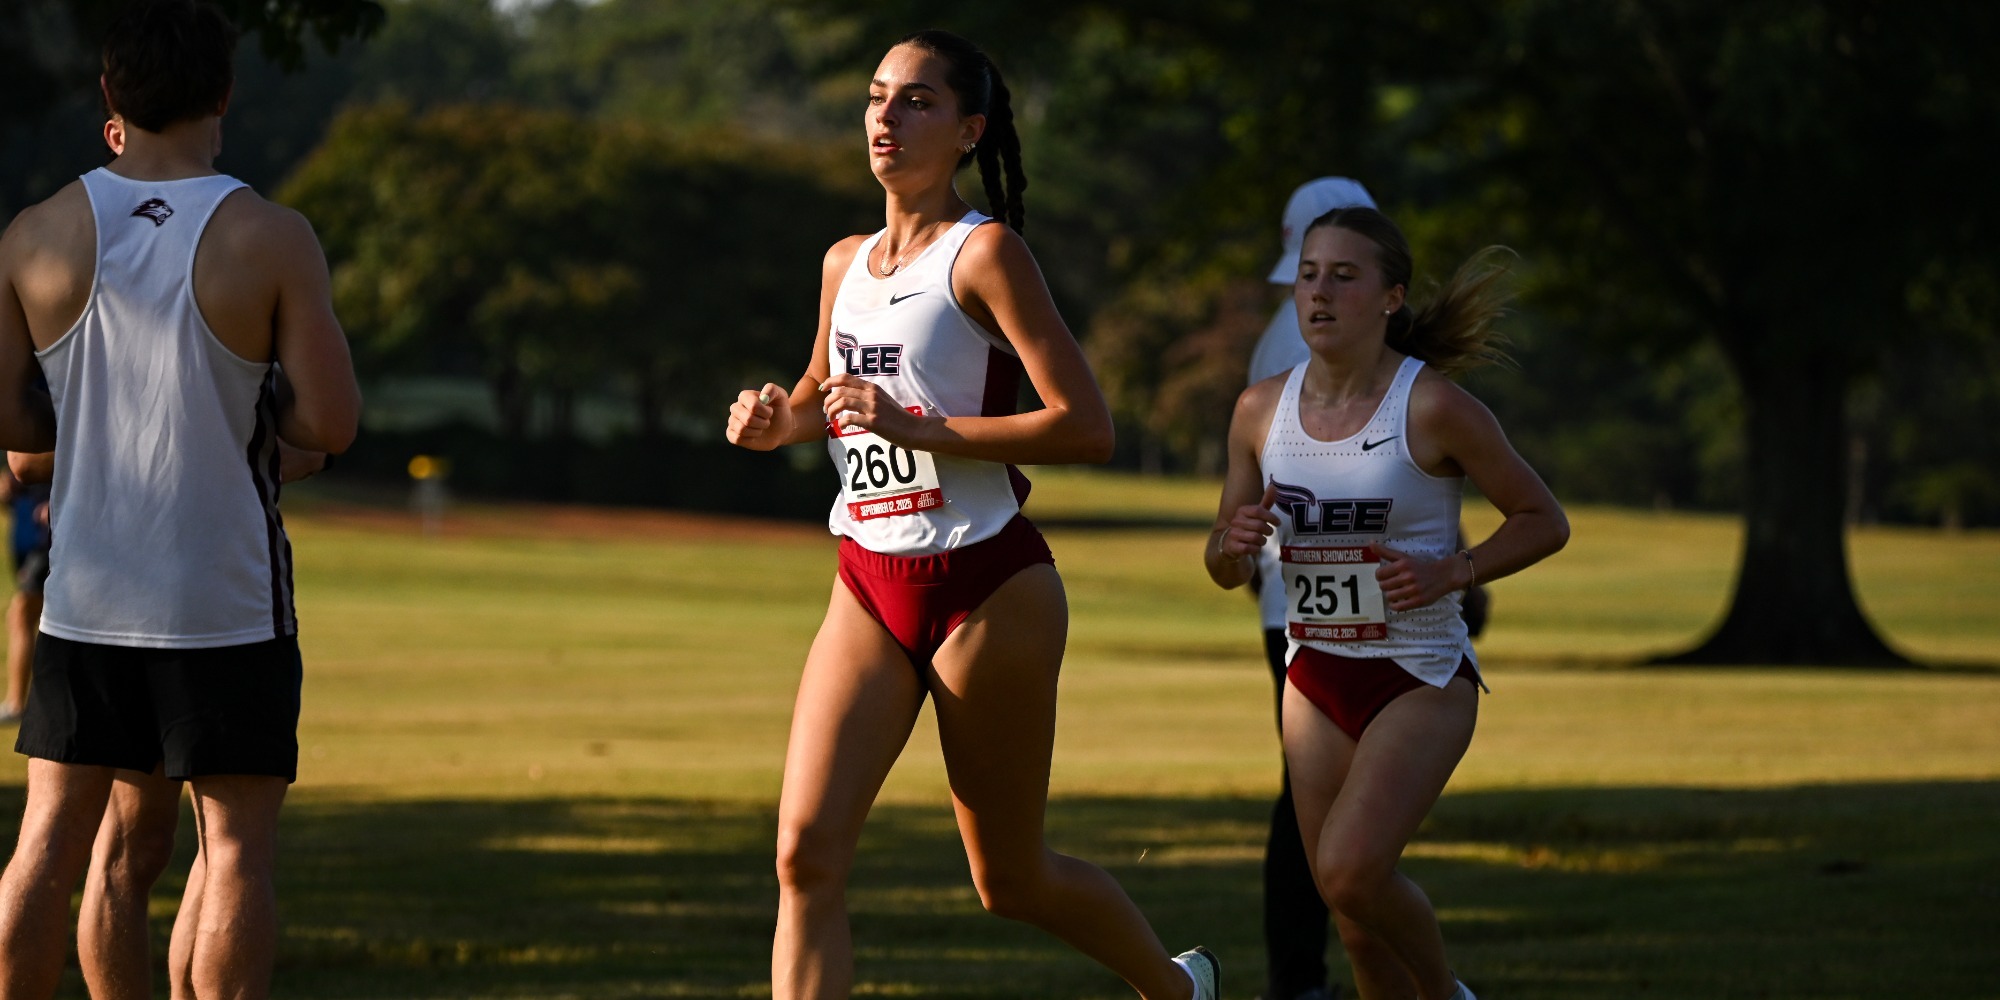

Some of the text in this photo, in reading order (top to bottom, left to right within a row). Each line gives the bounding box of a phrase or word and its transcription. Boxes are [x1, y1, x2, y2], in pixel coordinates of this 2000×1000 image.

[845, 344, 903, 377] LEE
[847, 444, 916, 492] 260
[860, 501, 889, 517] SEPTEMBER
[896, 498, 913, 511] 2025
[1291, 499, 1393, 536] LEE
[1290, 549, 1364, 562] SOUTHERN SHOWCASE
[1295, 574, 1360, 616] 251
[1304, 627, 1333, 639] SEPTEMBER
[1341, 627, 1358, 639] 2025
